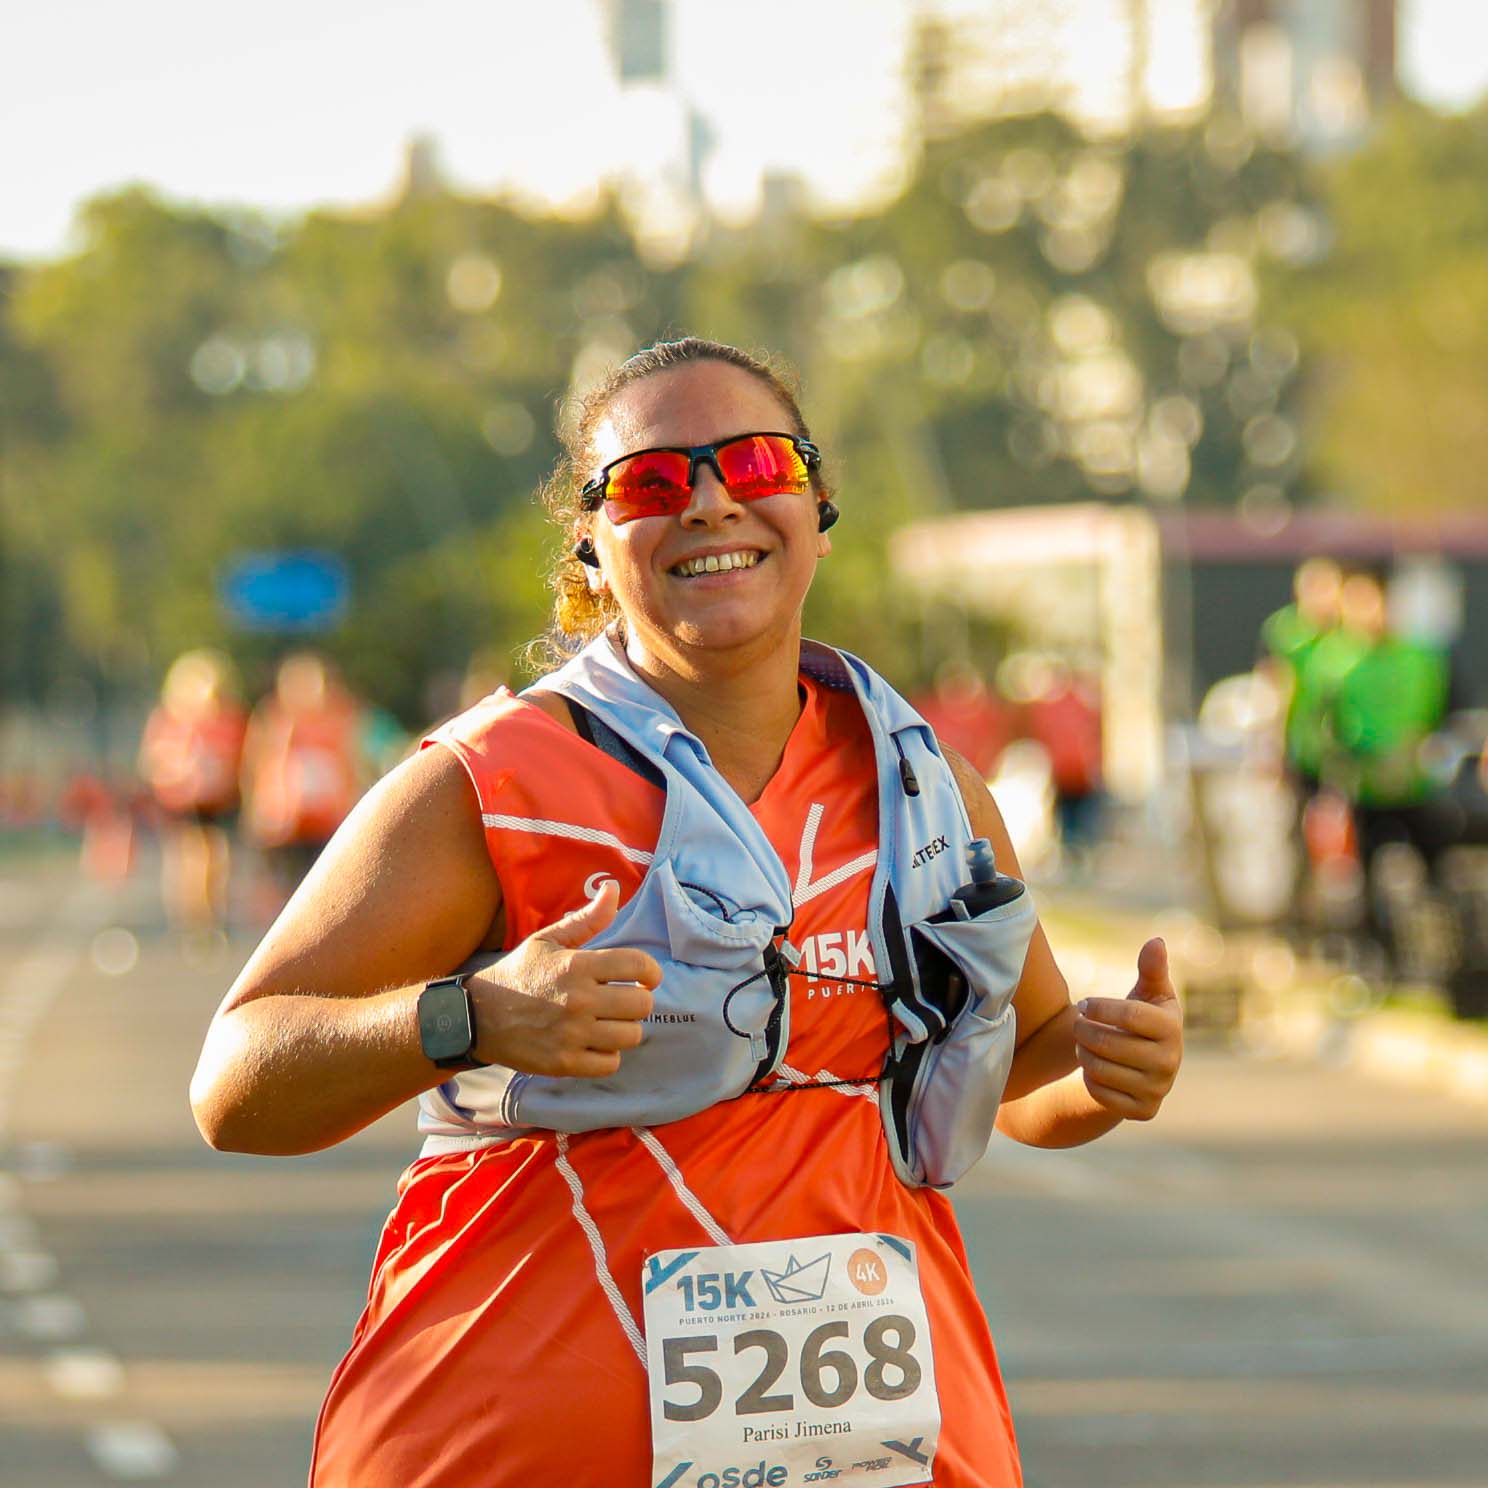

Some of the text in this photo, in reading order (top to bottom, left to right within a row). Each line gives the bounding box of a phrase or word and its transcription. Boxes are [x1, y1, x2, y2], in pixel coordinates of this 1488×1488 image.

[801, 929, 876, 983] 15K
[856, 1262, 881, 1282] 4K
[677, 1270, 757, 1312] 15K
[679, 1316, 714, 1326] PUERTO
[717, 1313, 746, 1323] NORTE
[779, 1306, 817, 1317] ROSARIO
[838, 1302, 848, 1311] DE
[850, 1299, 873, 1309] ABRIL
[662, 1314, 922, 1422] 5268
[743, 1420, 852, 1442] Parisi Jimena
